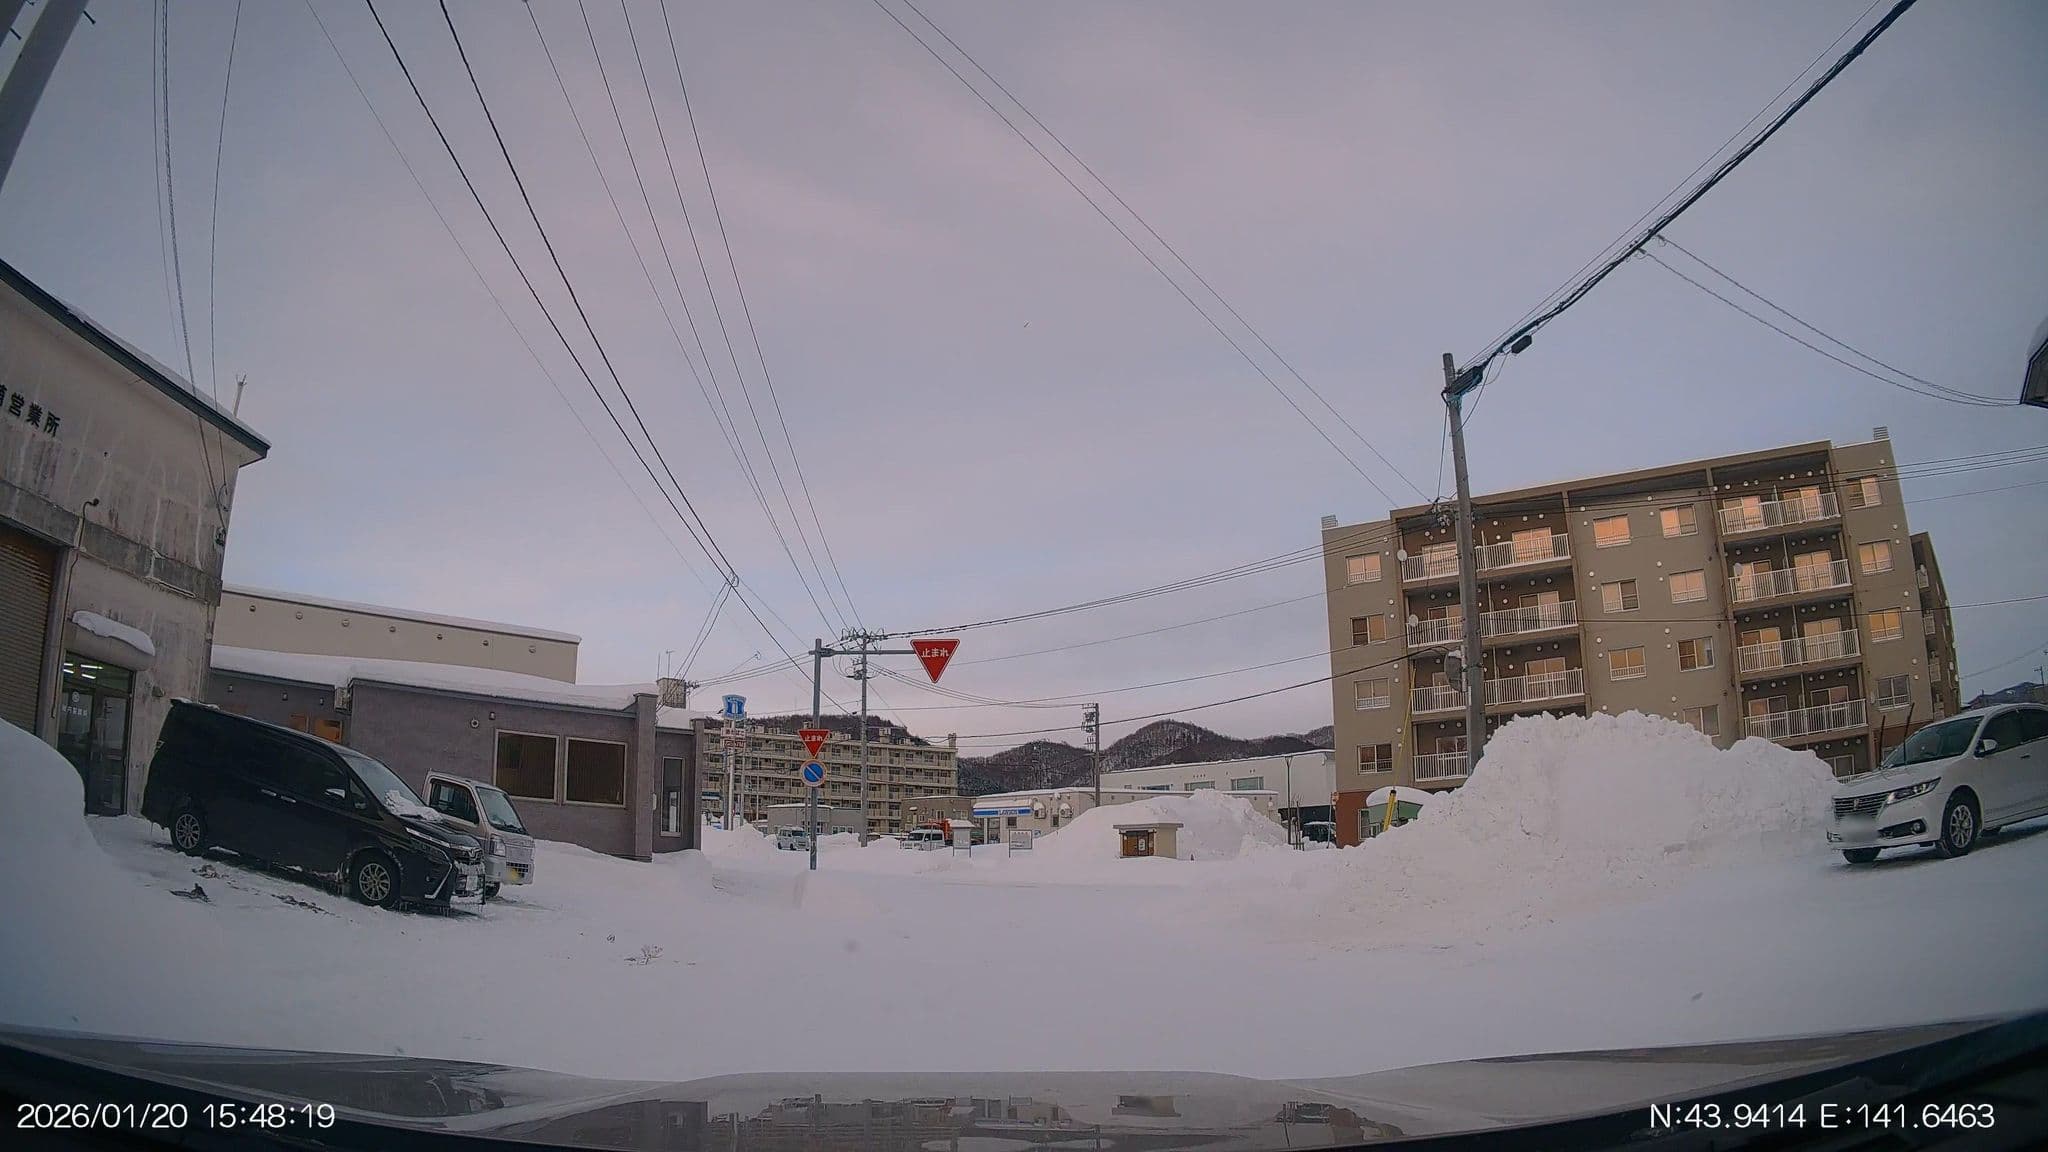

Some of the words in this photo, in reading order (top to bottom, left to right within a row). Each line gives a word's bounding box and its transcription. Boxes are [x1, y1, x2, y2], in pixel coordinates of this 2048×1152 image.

[921, 647, 949, 658] 止まれ
[804, 734, 823, 742] 止まれ
